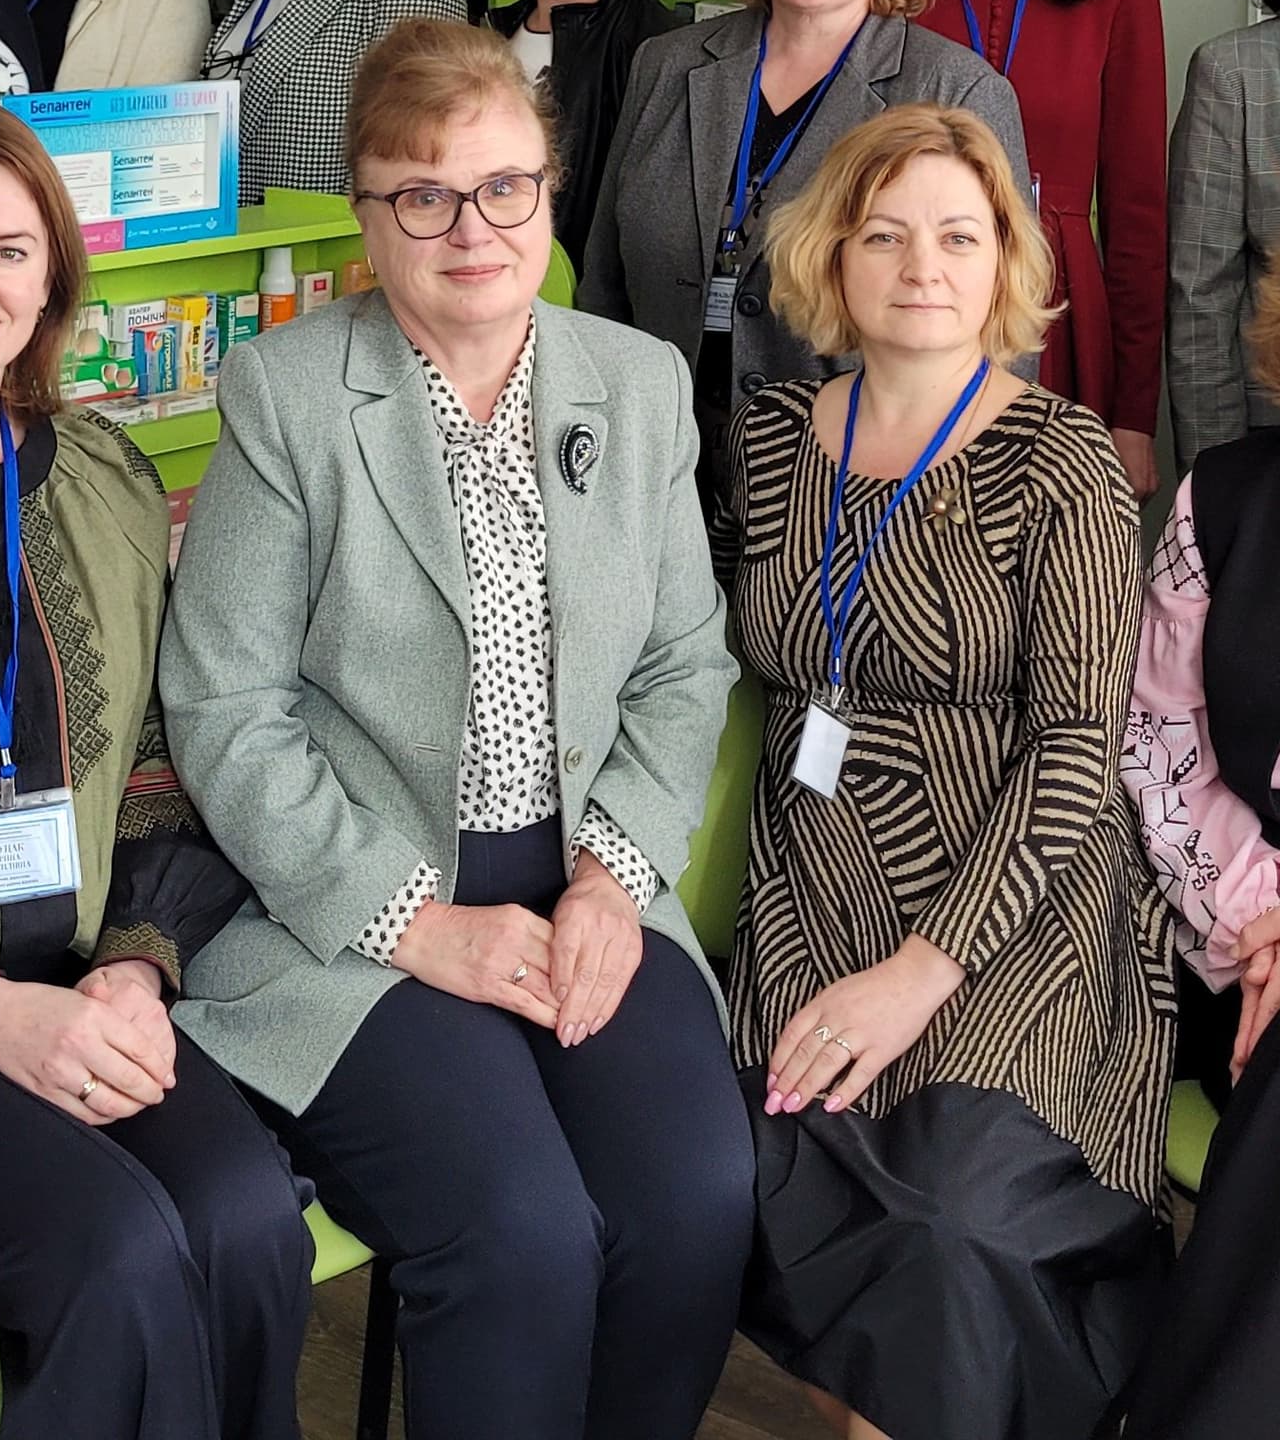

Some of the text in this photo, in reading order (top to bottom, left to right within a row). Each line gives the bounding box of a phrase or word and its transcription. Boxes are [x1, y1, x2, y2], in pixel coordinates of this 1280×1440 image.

[30, 98, 92, 115] Бепантен
[113, 154, 154, 166] Бепантен
[113, 188, 153, 200] Бепантен
